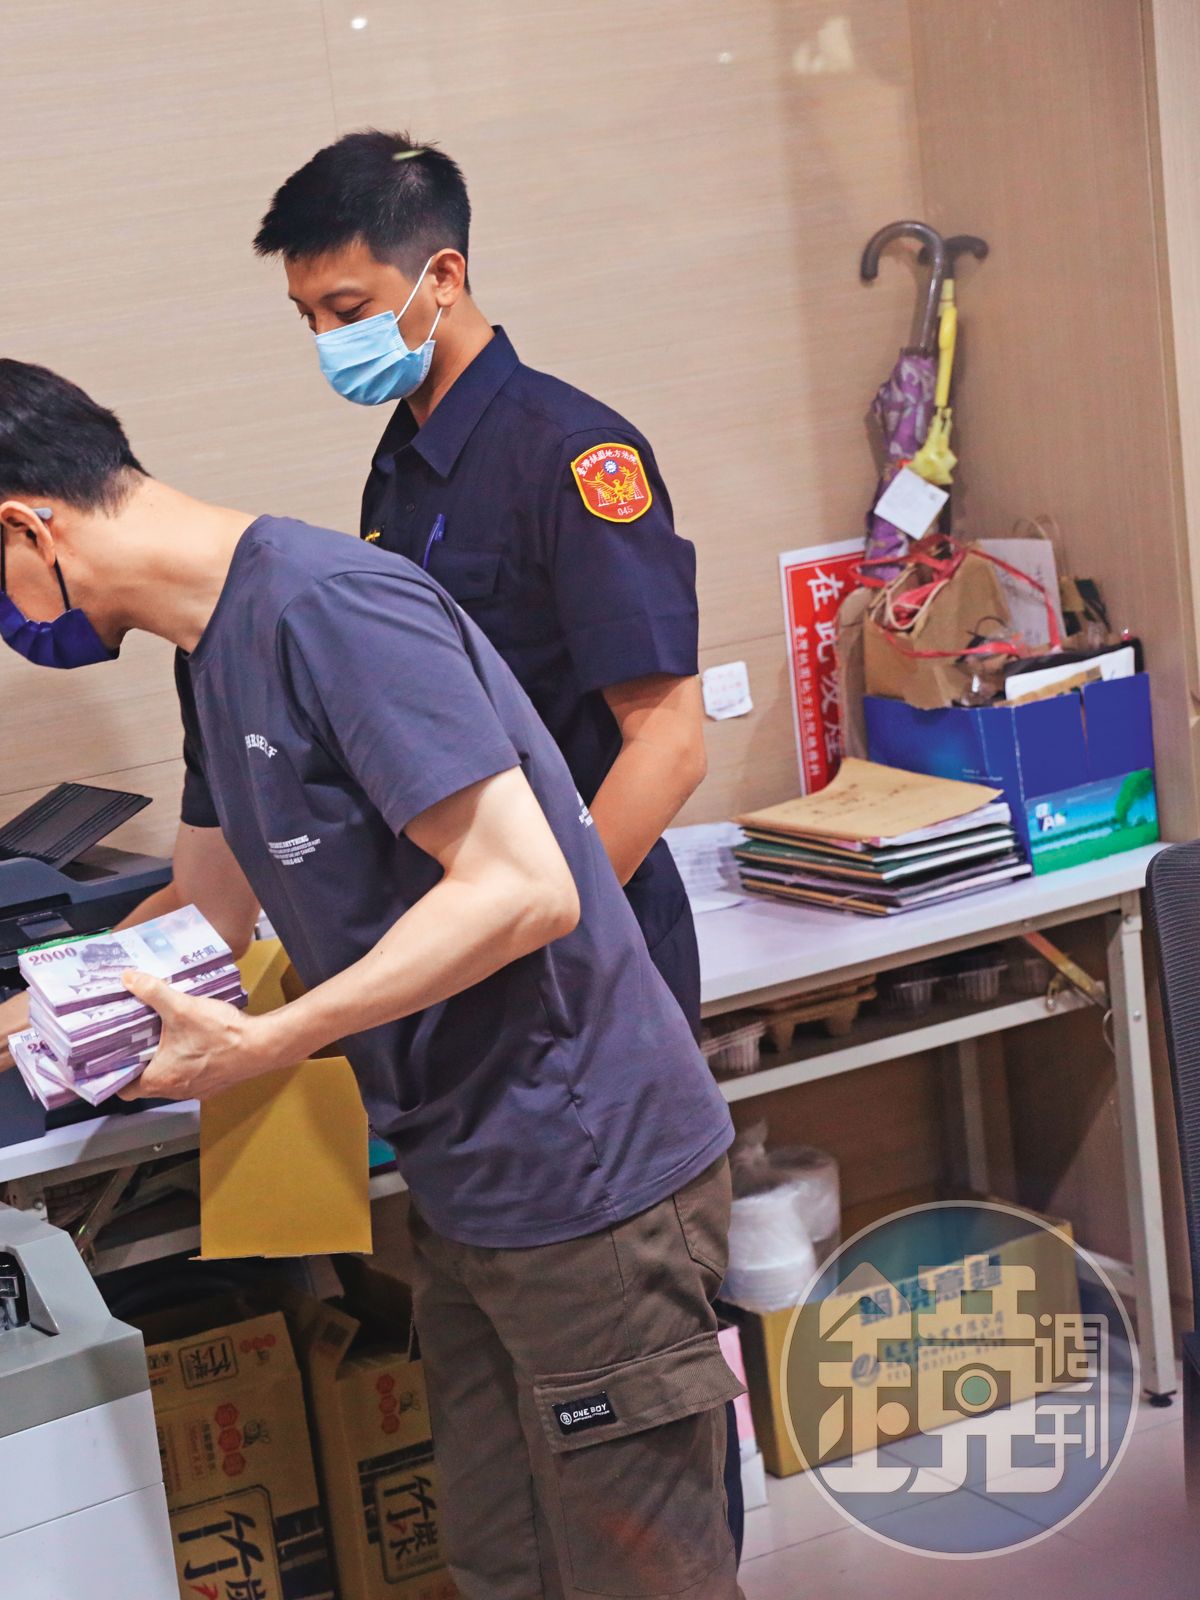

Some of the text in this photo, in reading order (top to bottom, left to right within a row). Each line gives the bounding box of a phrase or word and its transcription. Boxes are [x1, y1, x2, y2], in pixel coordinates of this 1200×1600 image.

[28, 946, 78, 966] 2000
[572, 1408, 589, 1418] ONE
[590, 1403, 607, 1413] BOY
